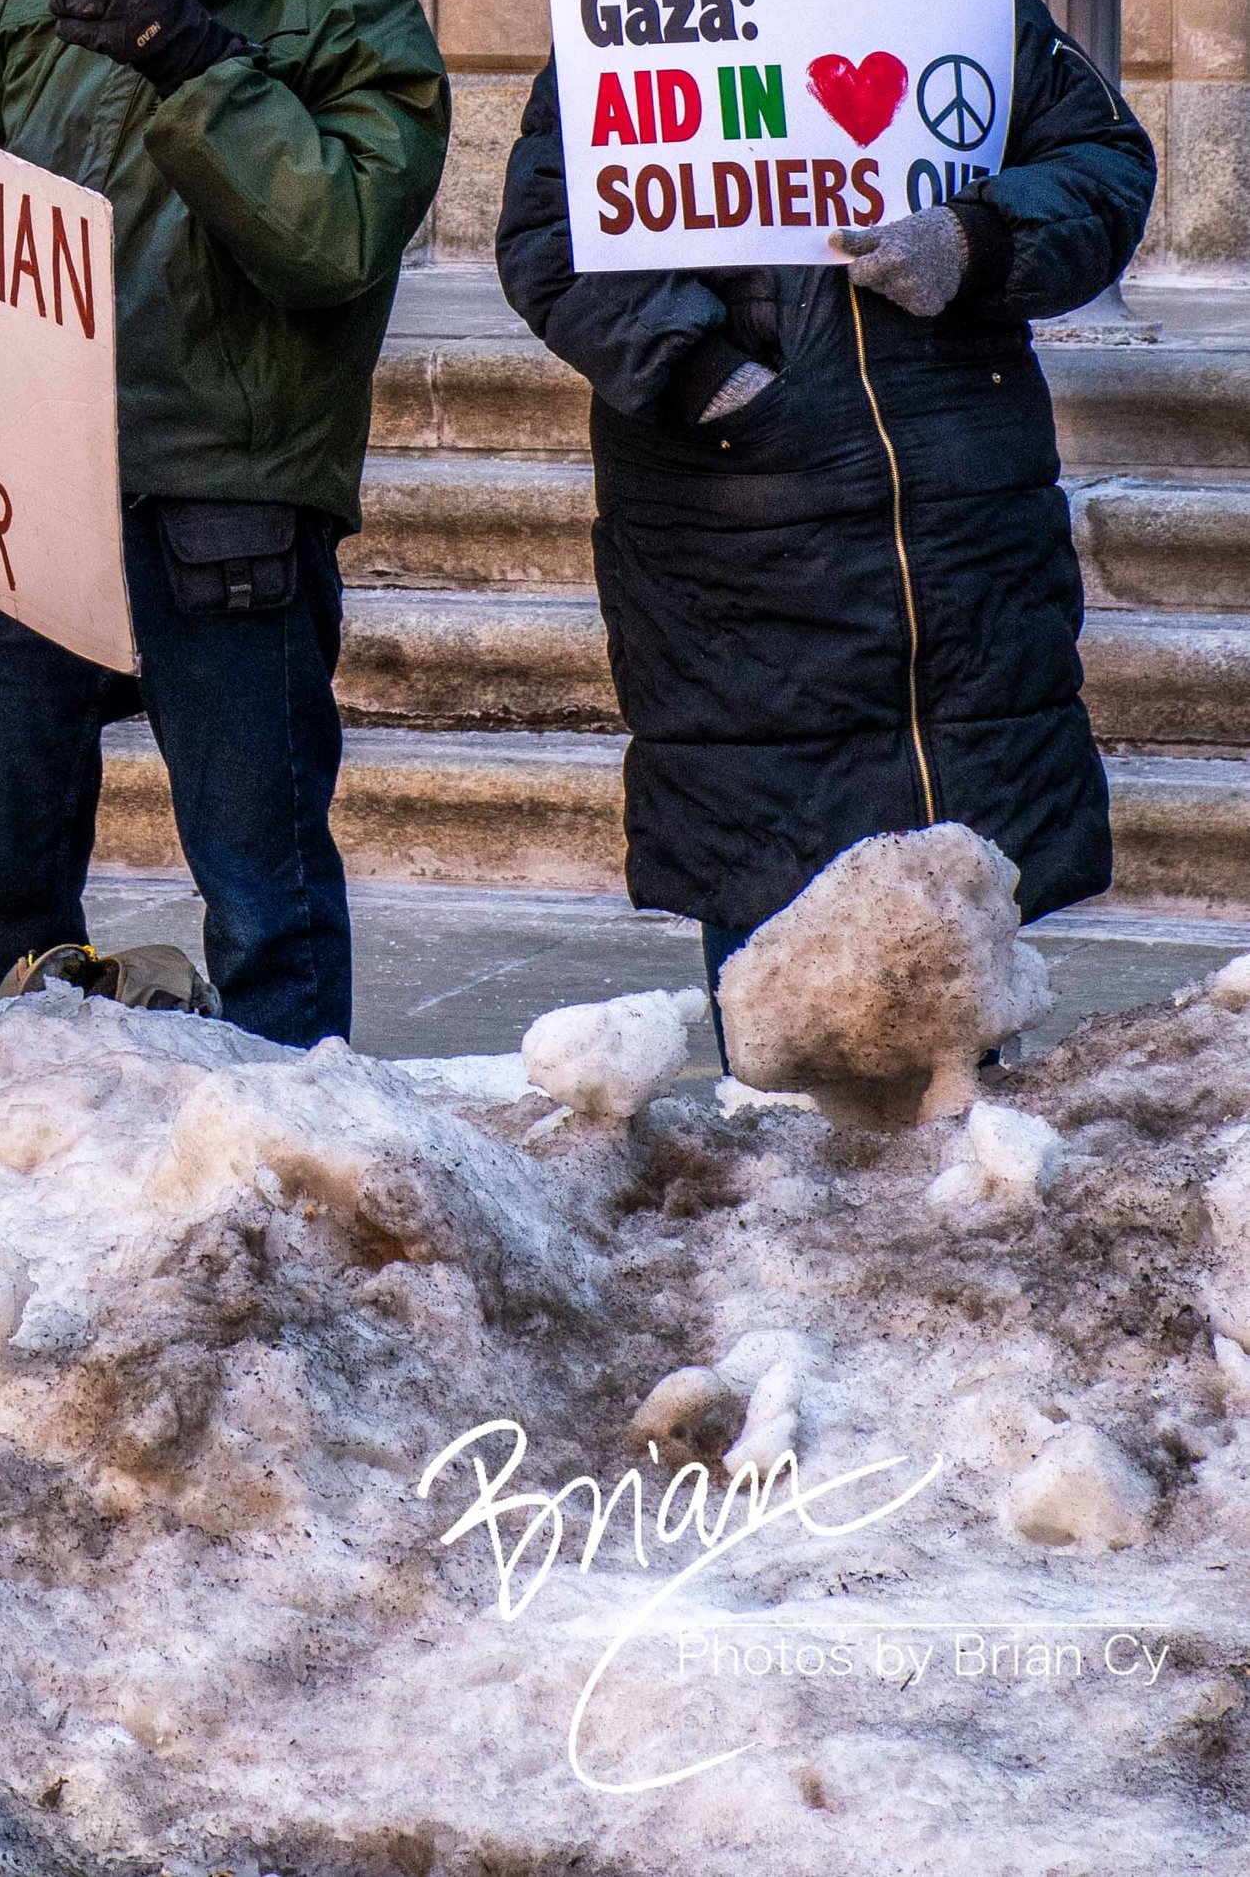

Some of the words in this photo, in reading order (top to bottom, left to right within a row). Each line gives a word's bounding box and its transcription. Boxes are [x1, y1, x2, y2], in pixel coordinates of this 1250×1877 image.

[137, 21, 161, 47] HEAD
[590, 68, 702, 147] AID
[717, 64, 789, 140] IN
[596, 157, 886, 236] SOLDIERS
